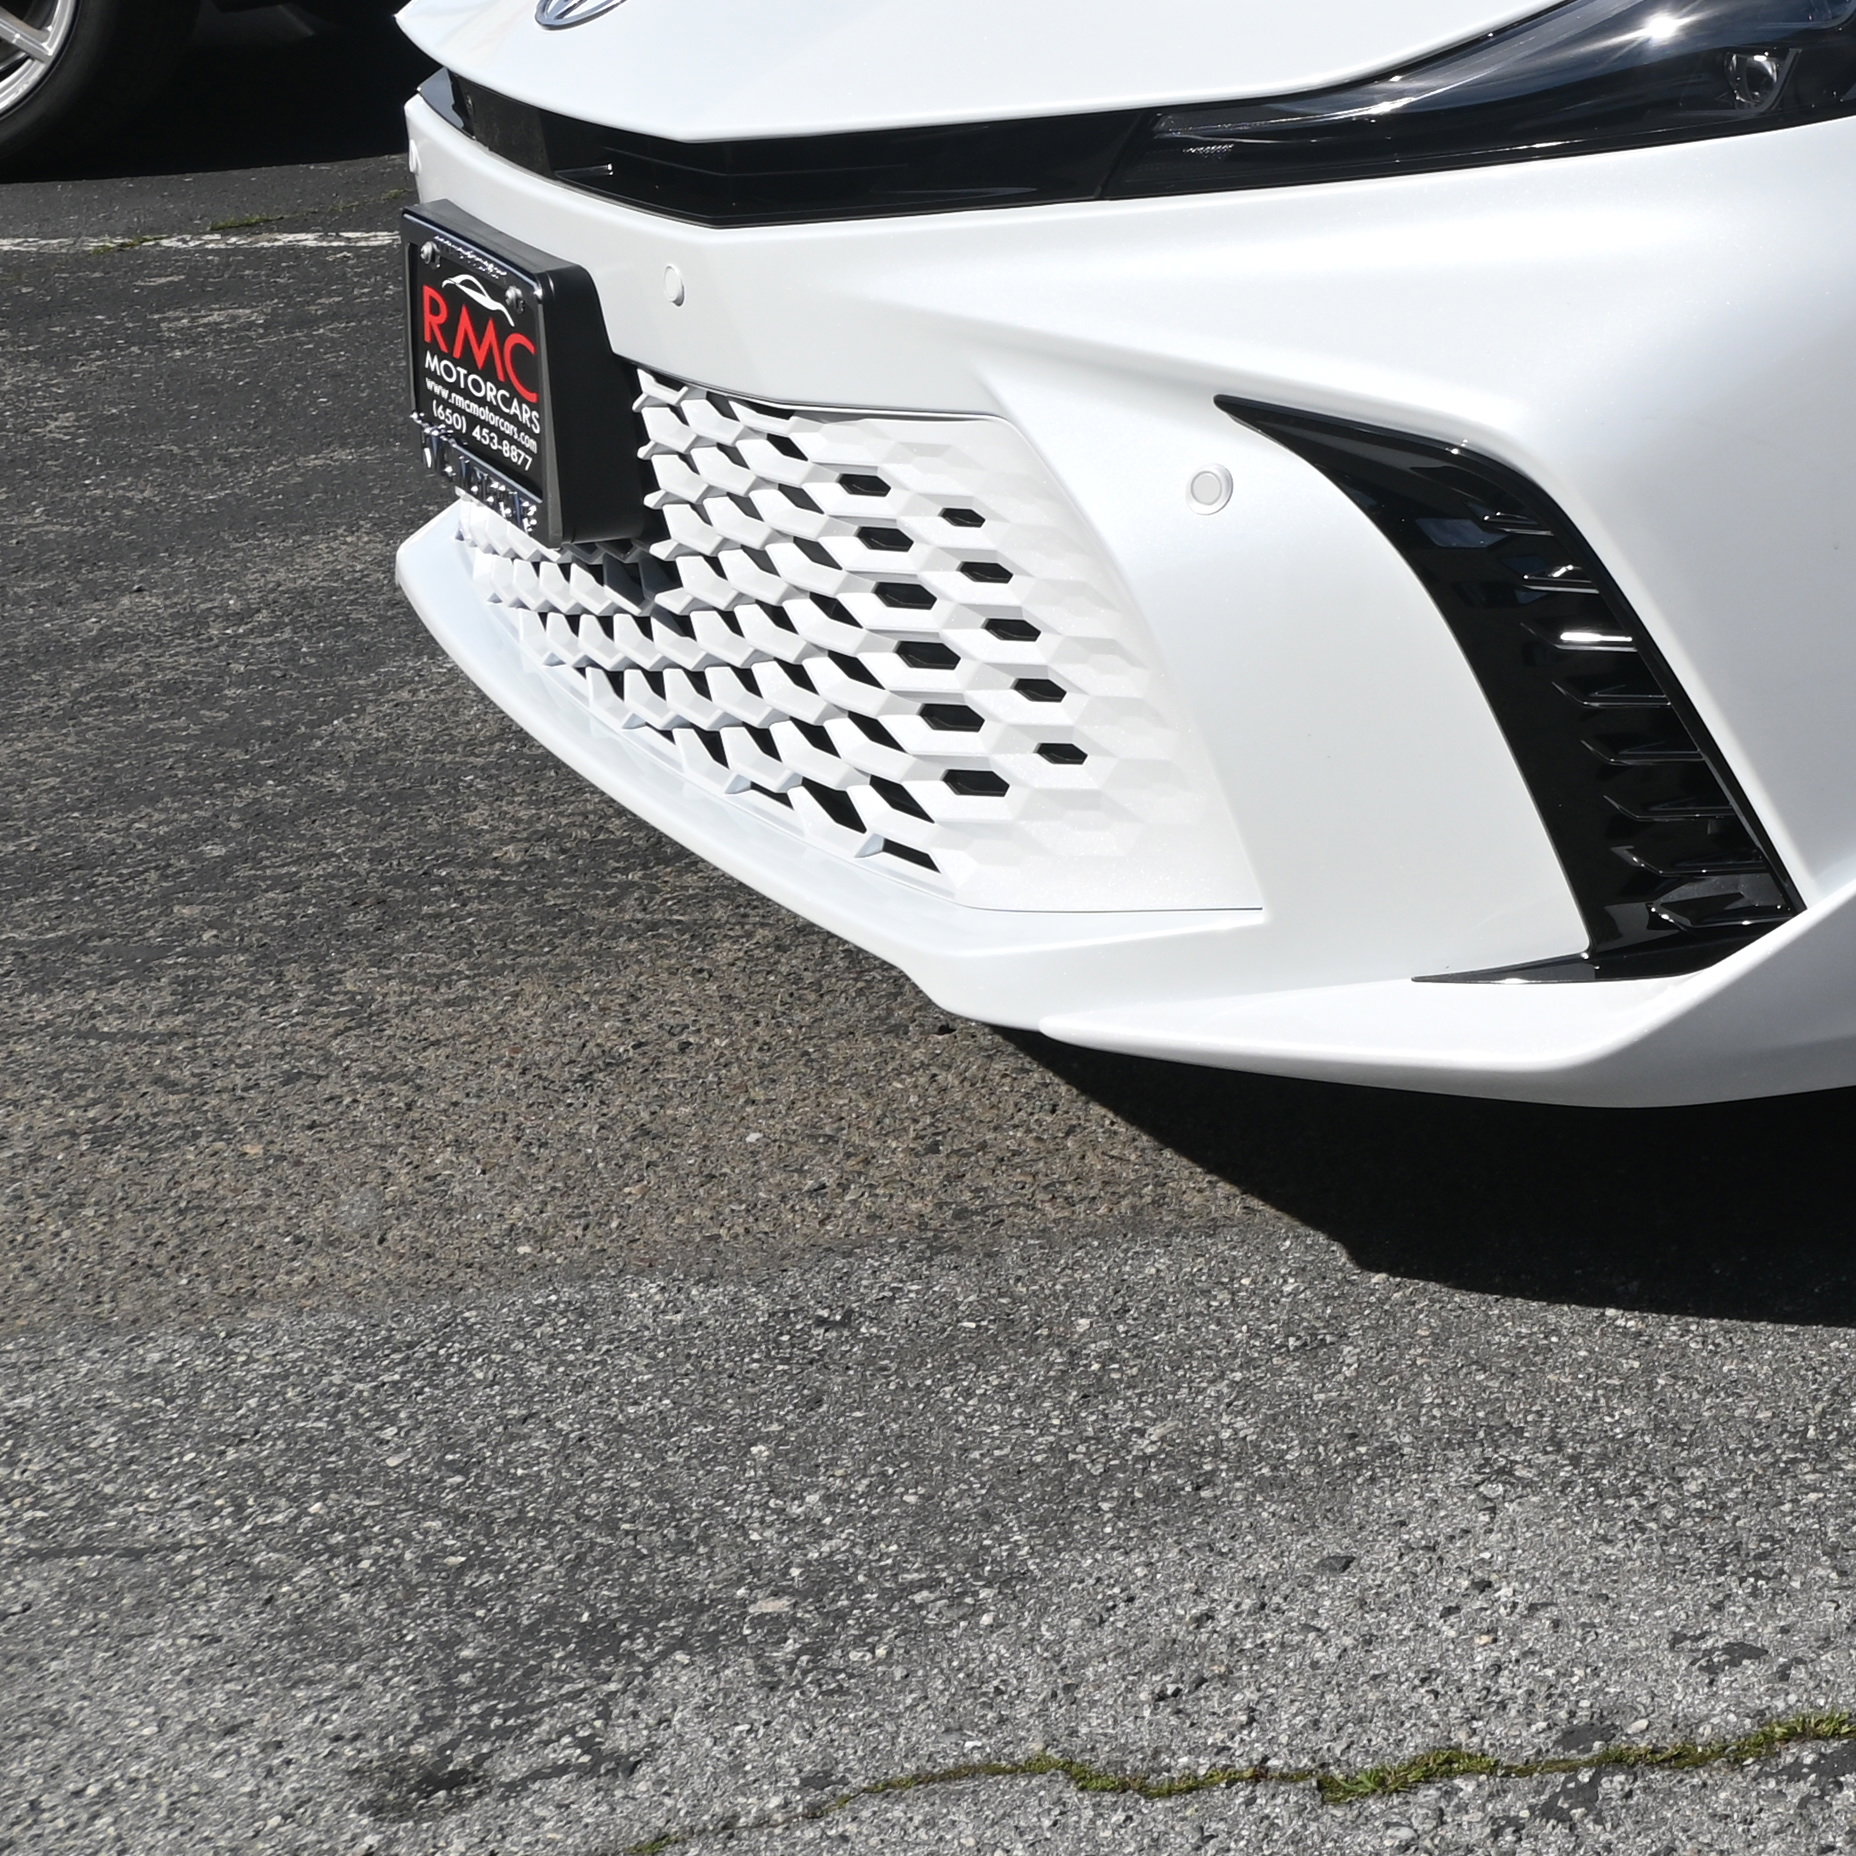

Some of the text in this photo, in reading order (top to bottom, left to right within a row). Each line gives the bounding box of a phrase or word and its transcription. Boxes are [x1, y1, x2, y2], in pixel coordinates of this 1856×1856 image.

[422, 285, 540, 403] RMC
[424, 350, 541, 435] MOTORCARS
[425, 377, 538, 454] www.rmcmotorcars.com
[432, 399, 533, 471] (650) 453-8877
